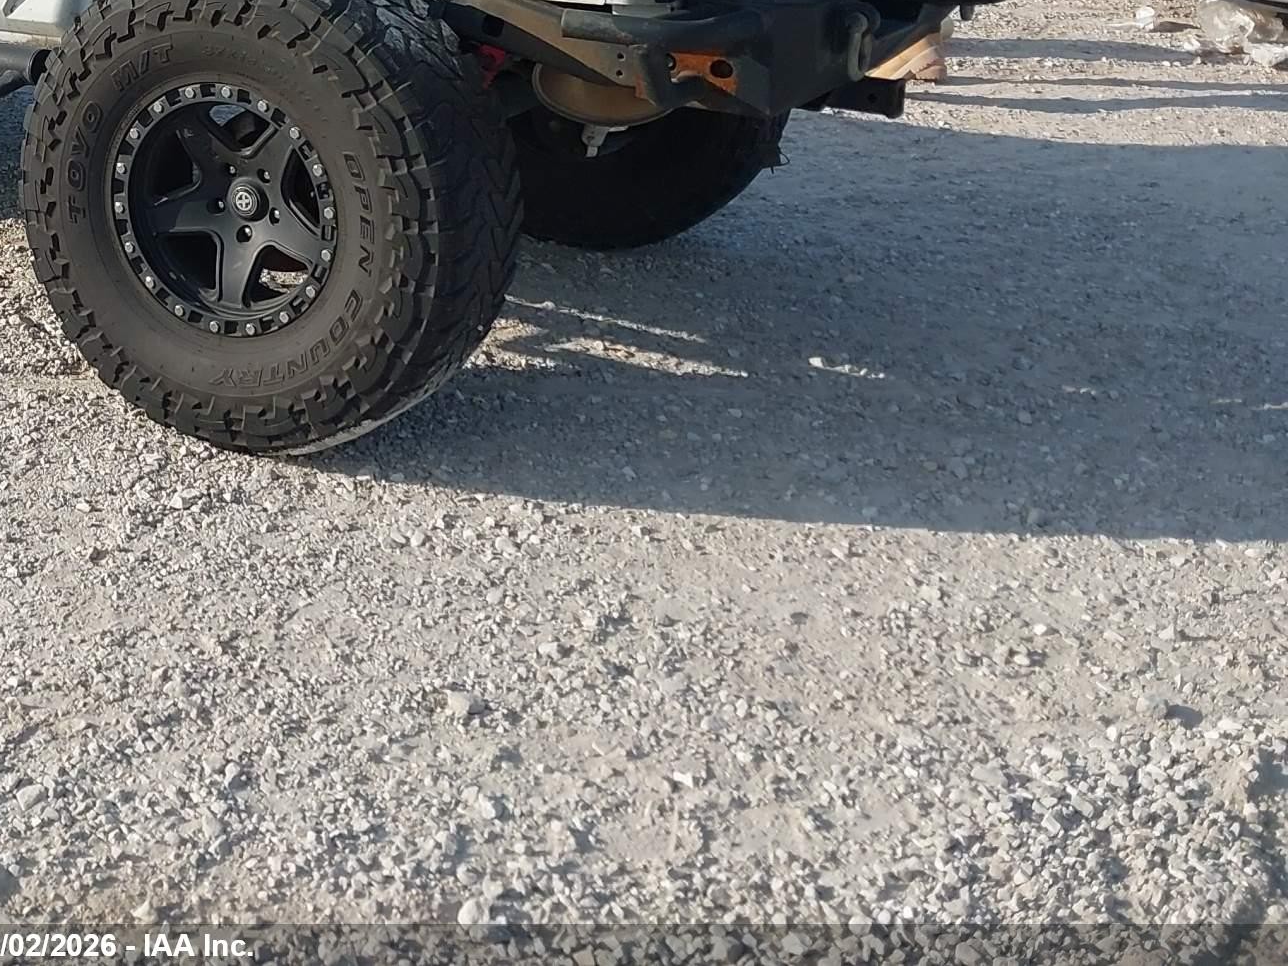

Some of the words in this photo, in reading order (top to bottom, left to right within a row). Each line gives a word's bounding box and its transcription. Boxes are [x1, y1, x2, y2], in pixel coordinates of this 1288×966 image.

[67, 100, 103, 225] TOYO
[111, 42, 174, 92] M/T
[343, 151, 375, 278] OPEN
[210, 289, 364, 388] COUNTRY
